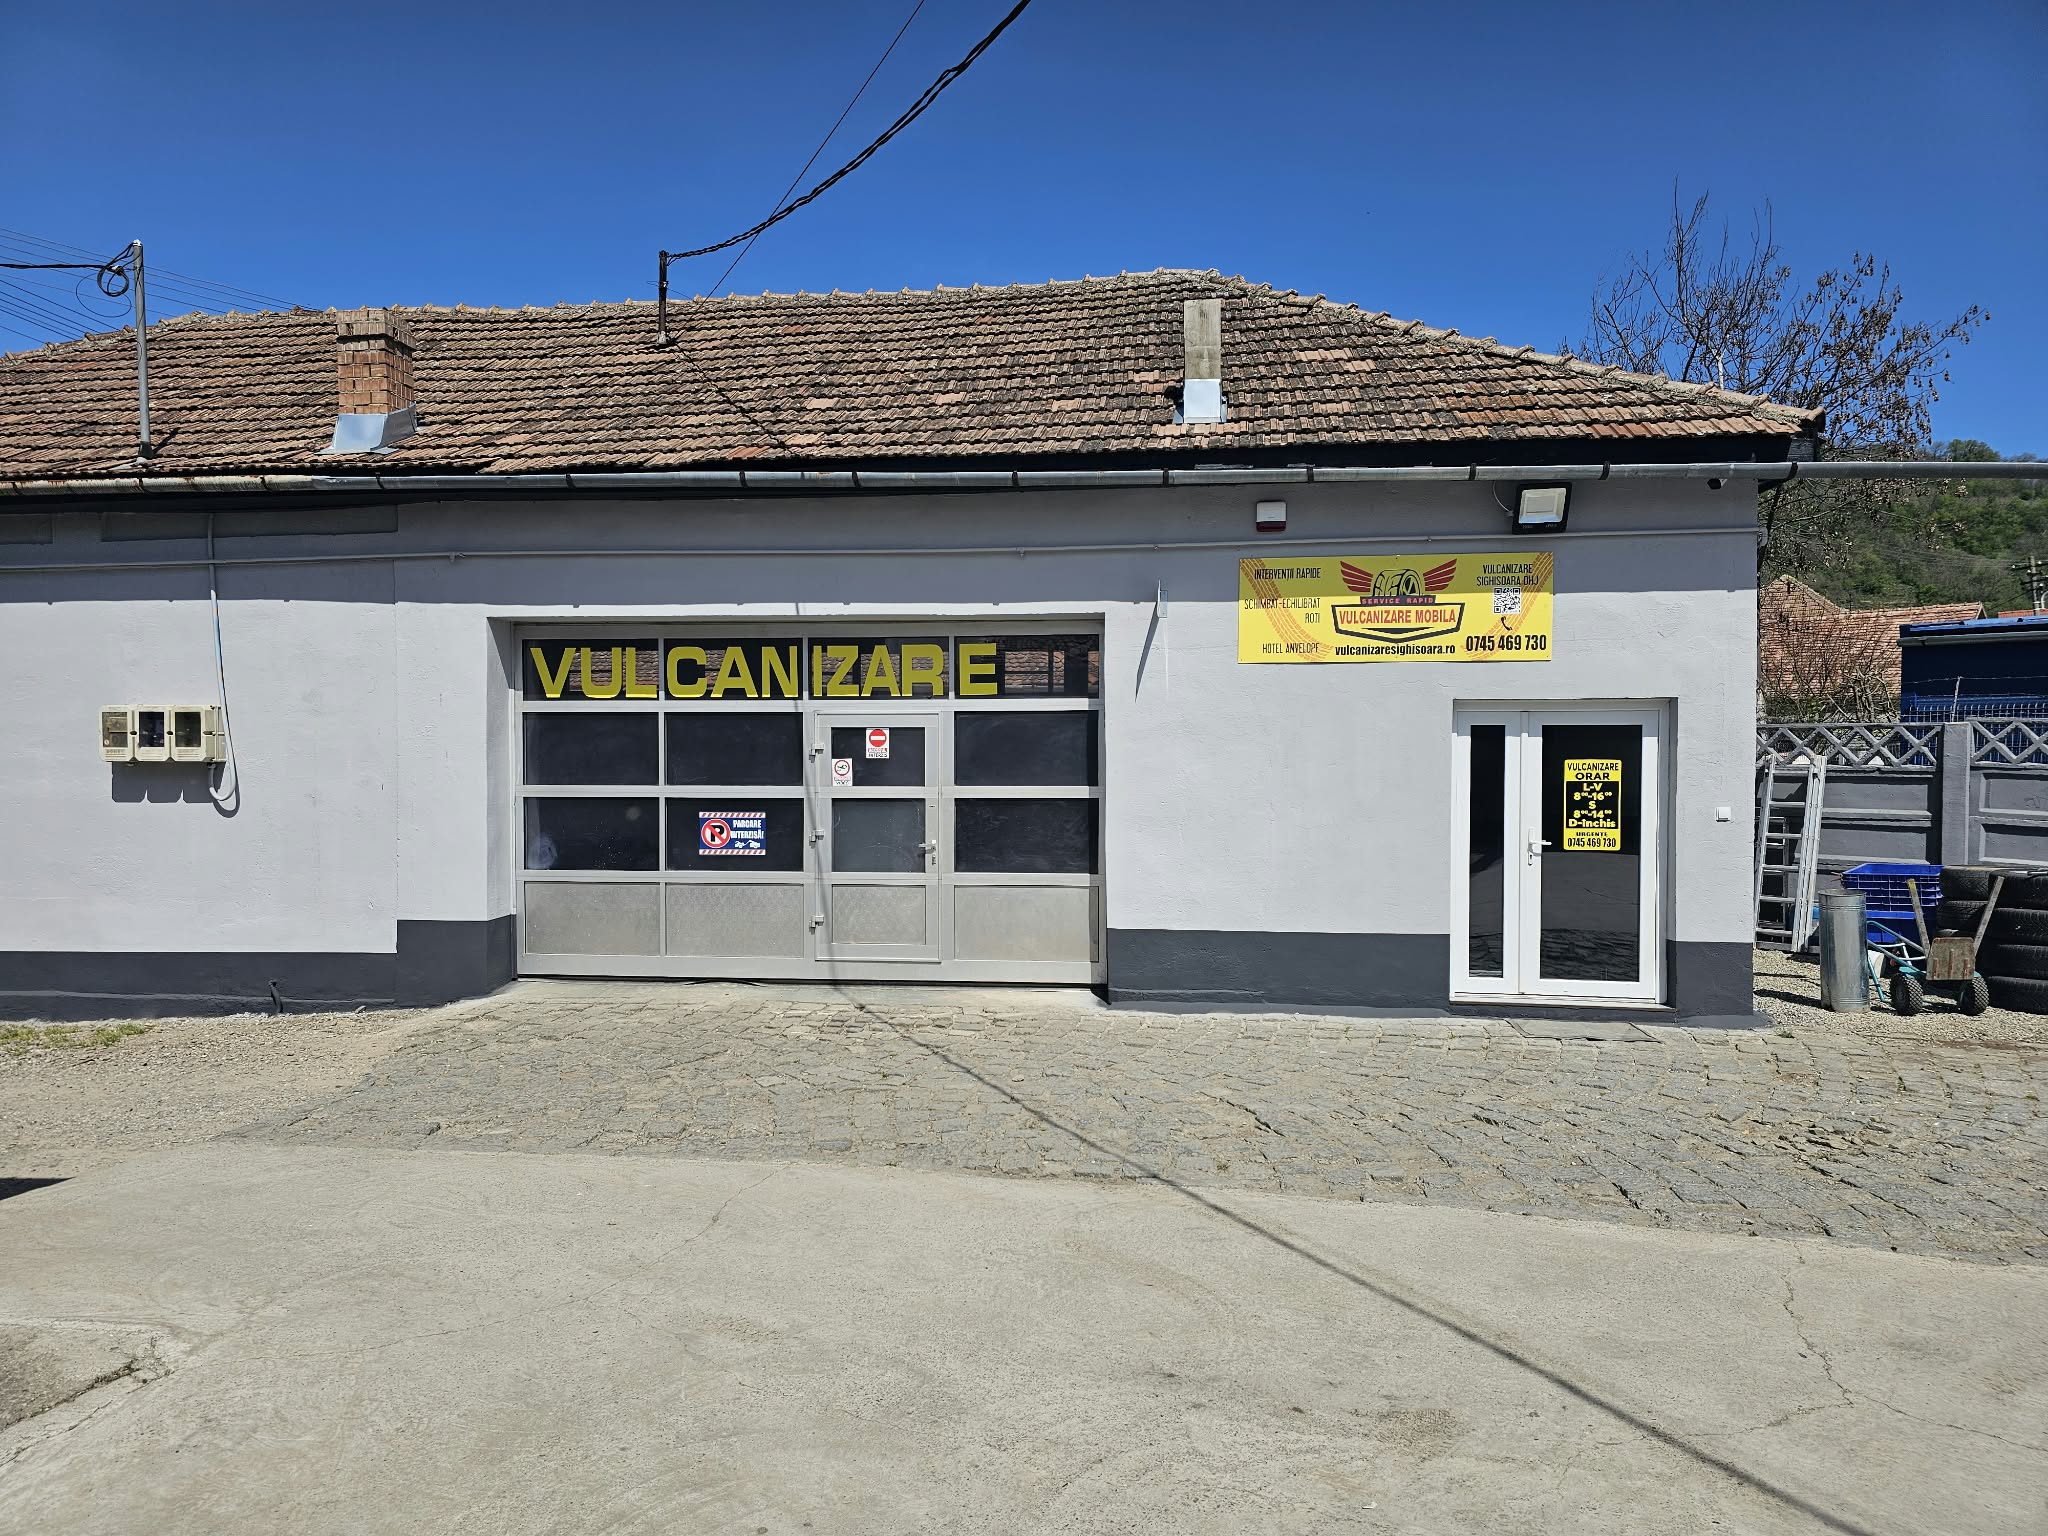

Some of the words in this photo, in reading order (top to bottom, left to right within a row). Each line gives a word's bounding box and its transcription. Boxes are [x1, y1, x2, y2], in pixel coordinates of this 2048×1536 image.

[1296, 567, 1321, 579] RAPIDE
[1482, 563, 1533, 574] VULCANIZARE
[1476, 575, 1521, 586] SIGHISOARA
[1339, 609, 1412, 624] VULCANIZARE
[1415, 609, 1456, 623] MOBILA
[1262, 643, 1283, 654] HOTEL
[1466, 636, 1495, 651] 0745
[1498, 635, 1522, 651] 469
[1525, 635, 1547, 650] 730
[1335, 643, 1456, 657] vulcanizaresighisoara.ro
[530, 643, 997, 698] VULCANIZARE
[1567, 763, 1619, 771] VULCANIZARE
[1583, 783, 1603, 791] L-V
[1588, 801, 1597, 810] S
[732, 819, 762, 828] PARCARE
[1567, 838, 1585, 847] 0745
[1586, 838, 1601, 847] 469
[1603, 838, 1616, 847] 730
